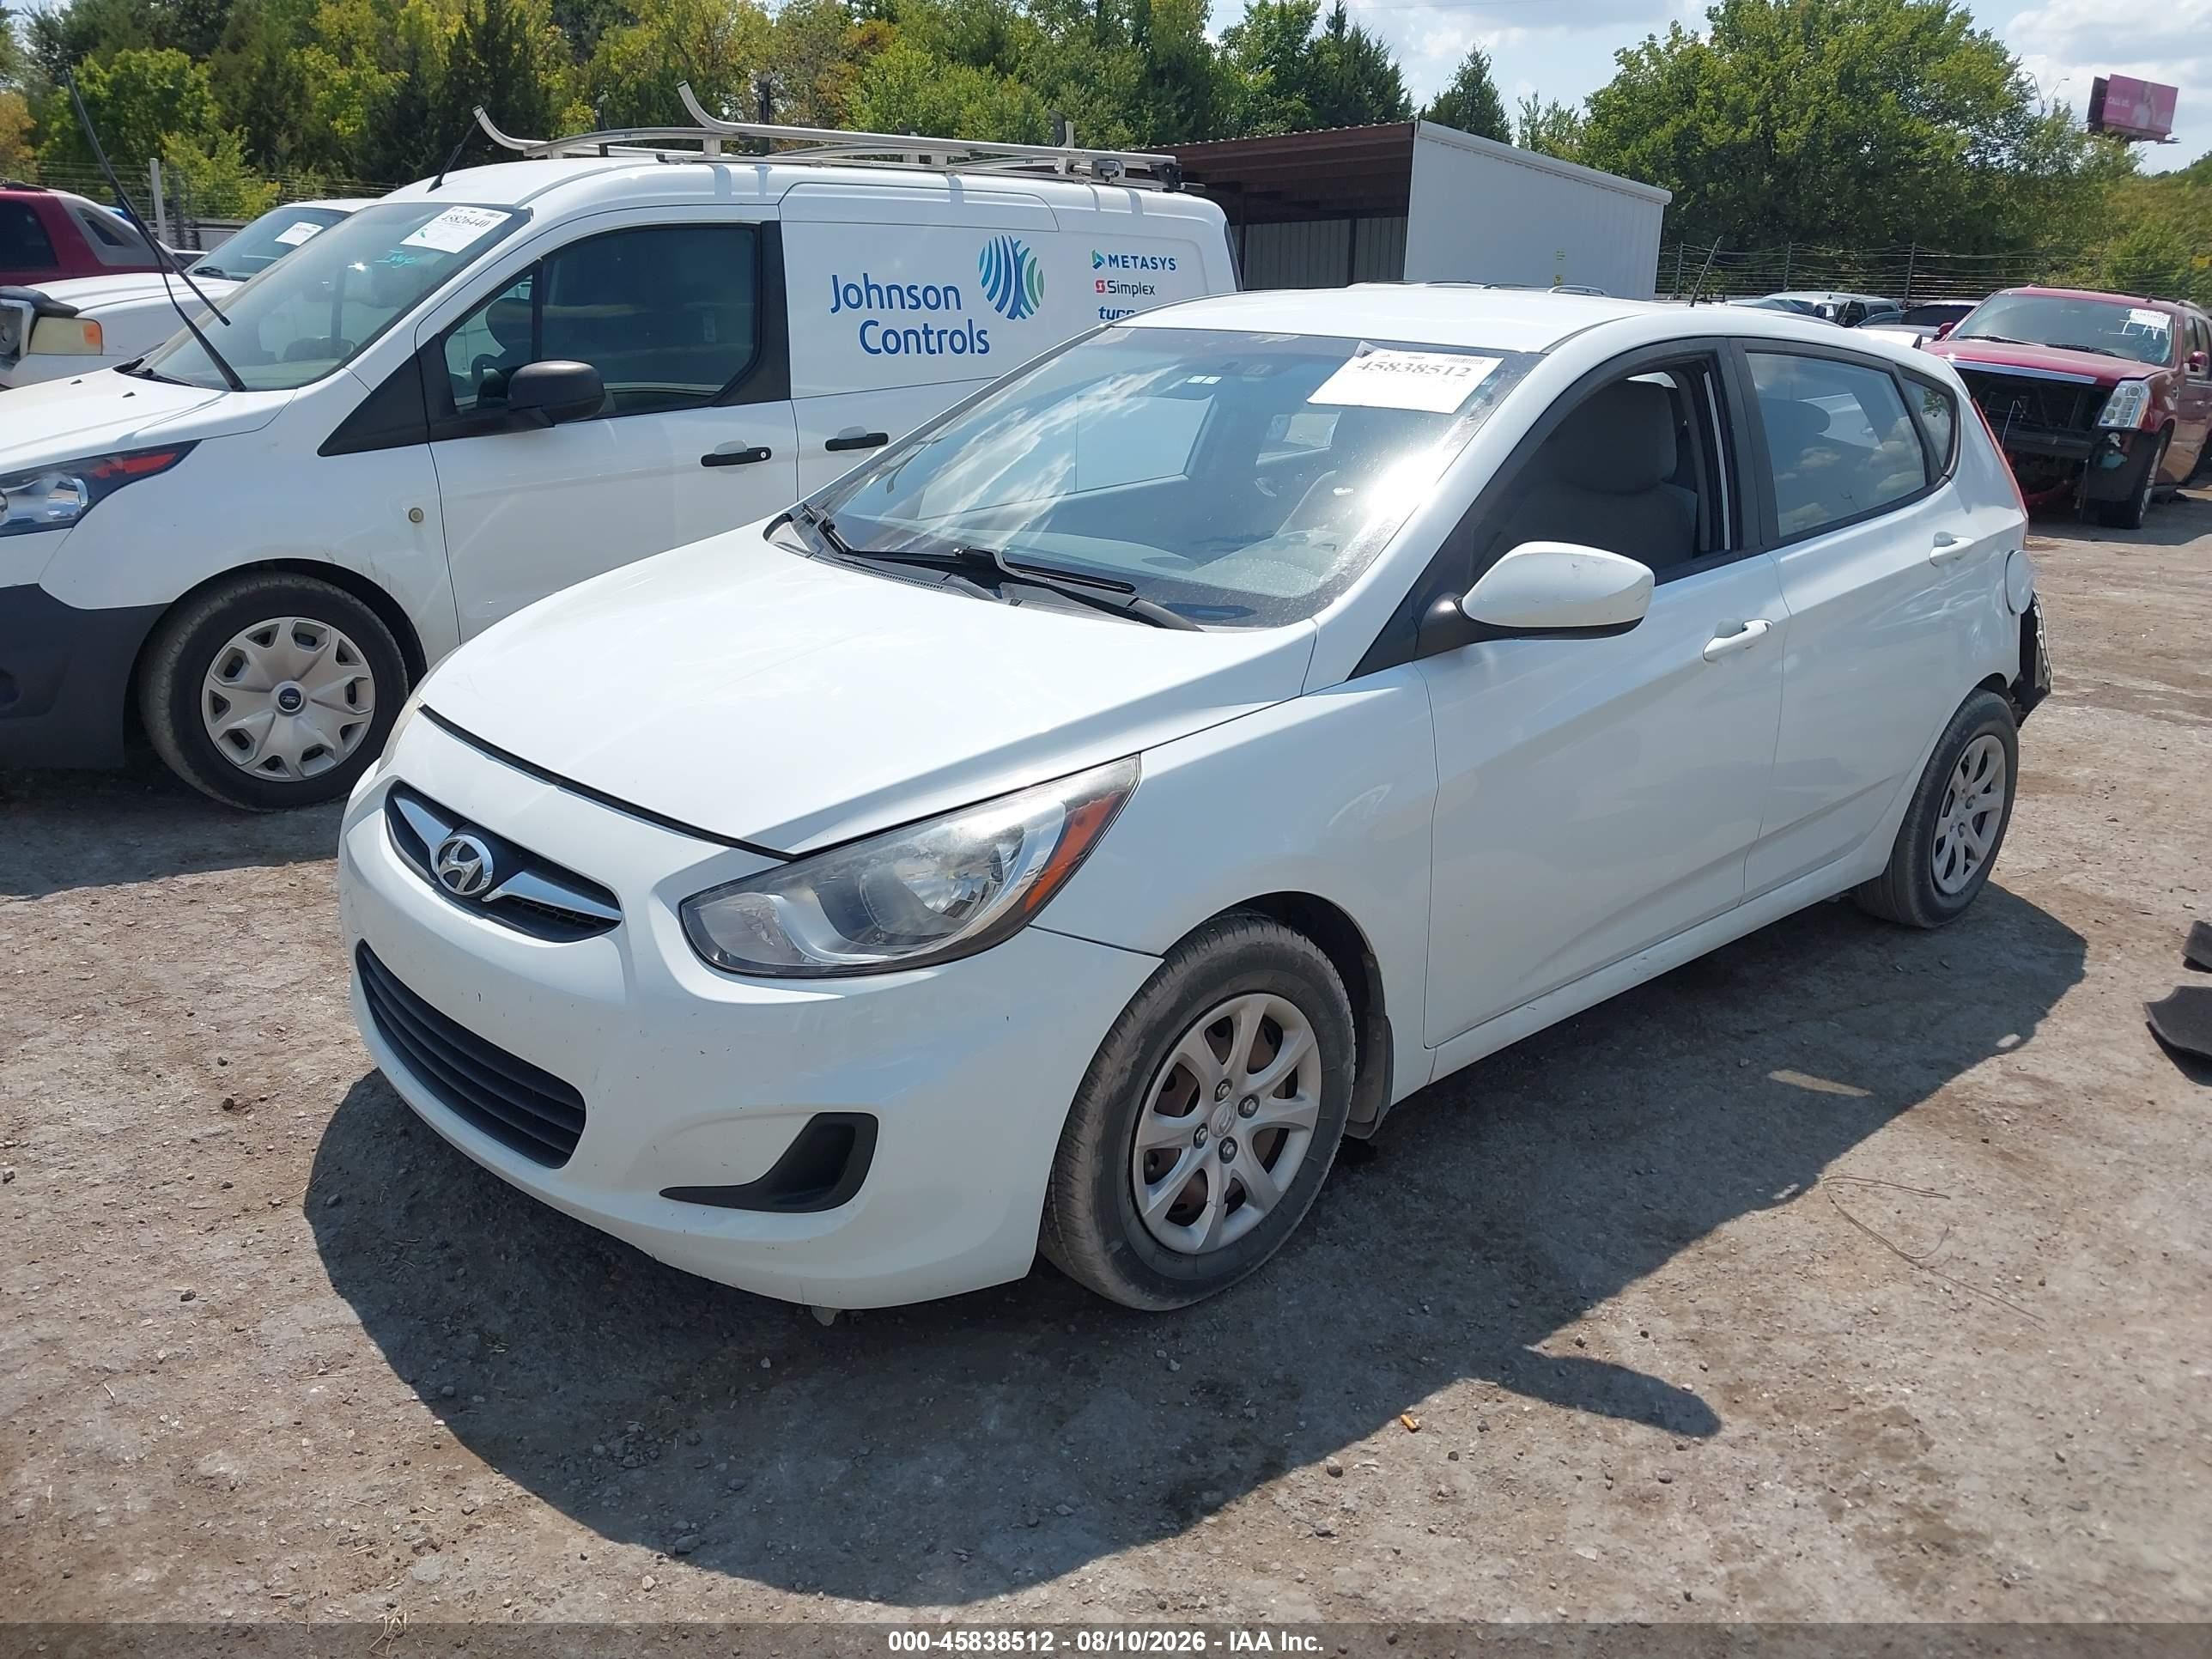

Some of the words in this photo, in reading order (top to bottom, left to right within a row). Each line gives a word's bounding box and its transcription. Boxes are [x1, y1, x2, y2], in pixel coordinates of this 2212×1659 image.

[1108, 254, 1176, 270] METASYS
[830, 272, 962, 313] Johnson
[1107, 280, 1156, 298] Simplex
[859, 319, 990, 355] Controls
[1357, 361, 1472, 377] 45838512
